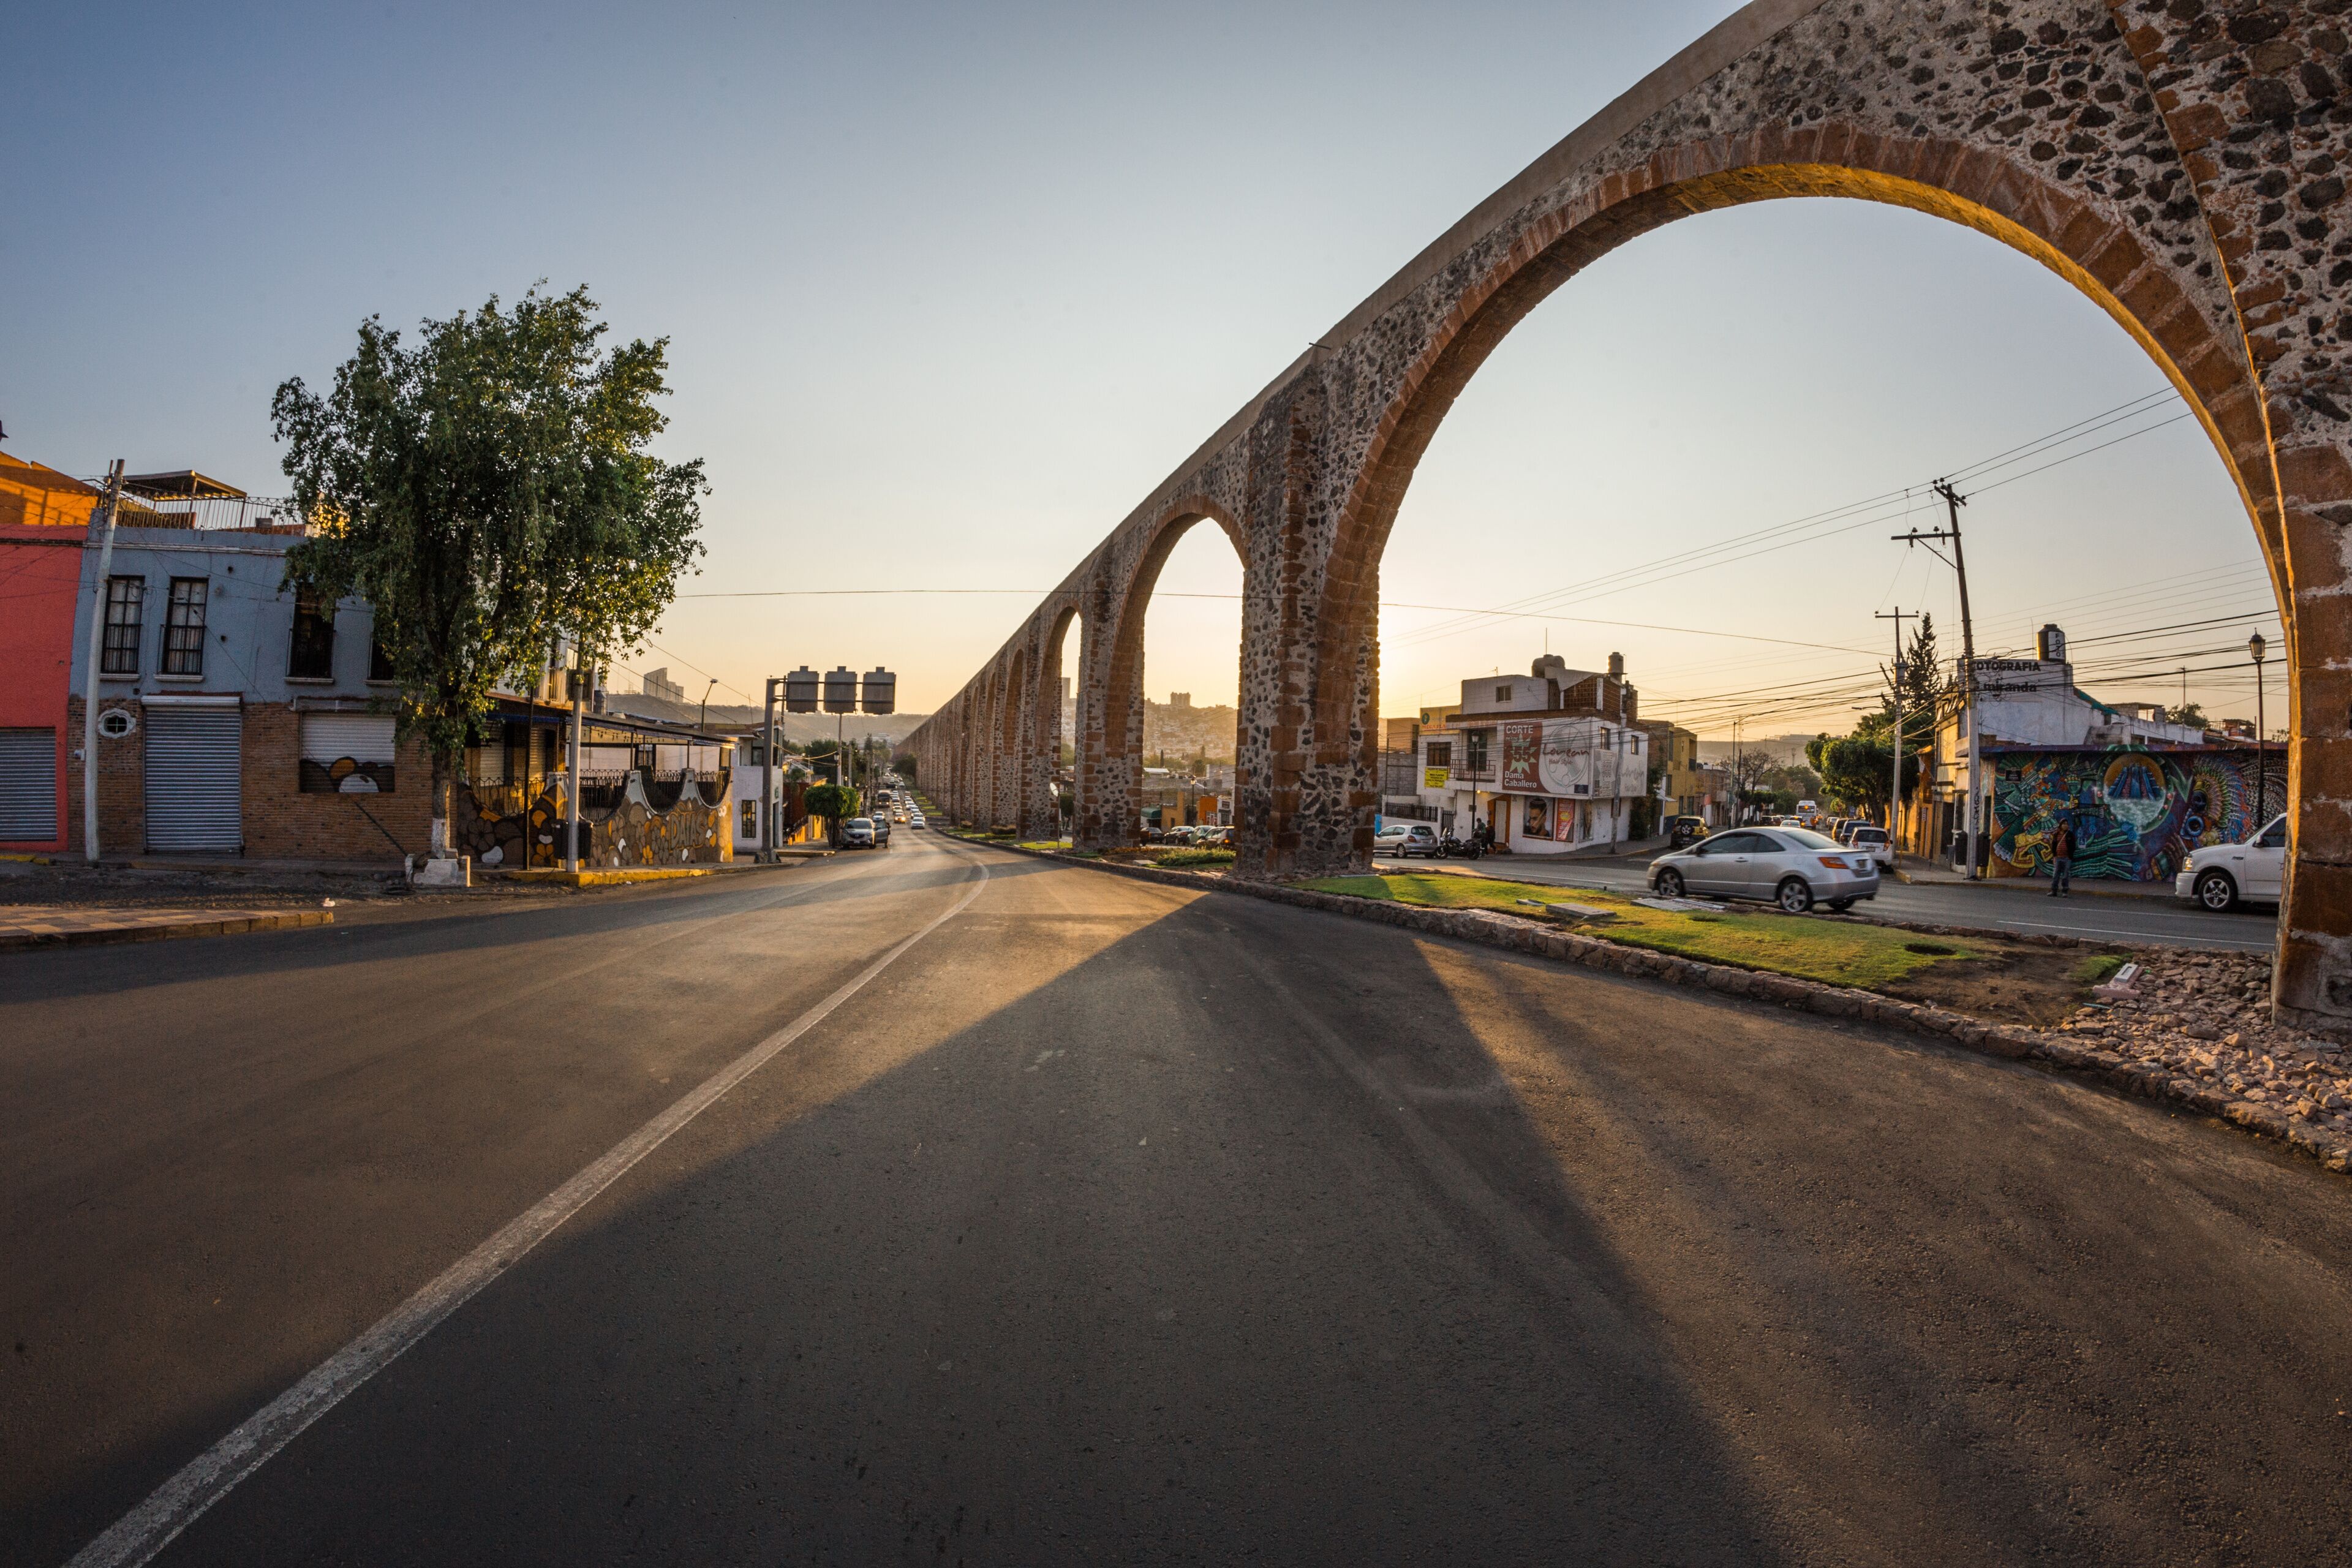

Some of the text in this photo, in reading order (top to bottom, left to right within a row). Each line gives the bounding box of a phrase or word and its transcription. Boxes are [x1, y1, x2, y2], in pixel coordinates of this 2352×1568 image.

[1984, 680, 2037, 692] miranda
[1506, 725, 1534, 734] CORTE
[1561, 757, 1574, 766] Style
[1504, 778, 1537, 788] Caballero
